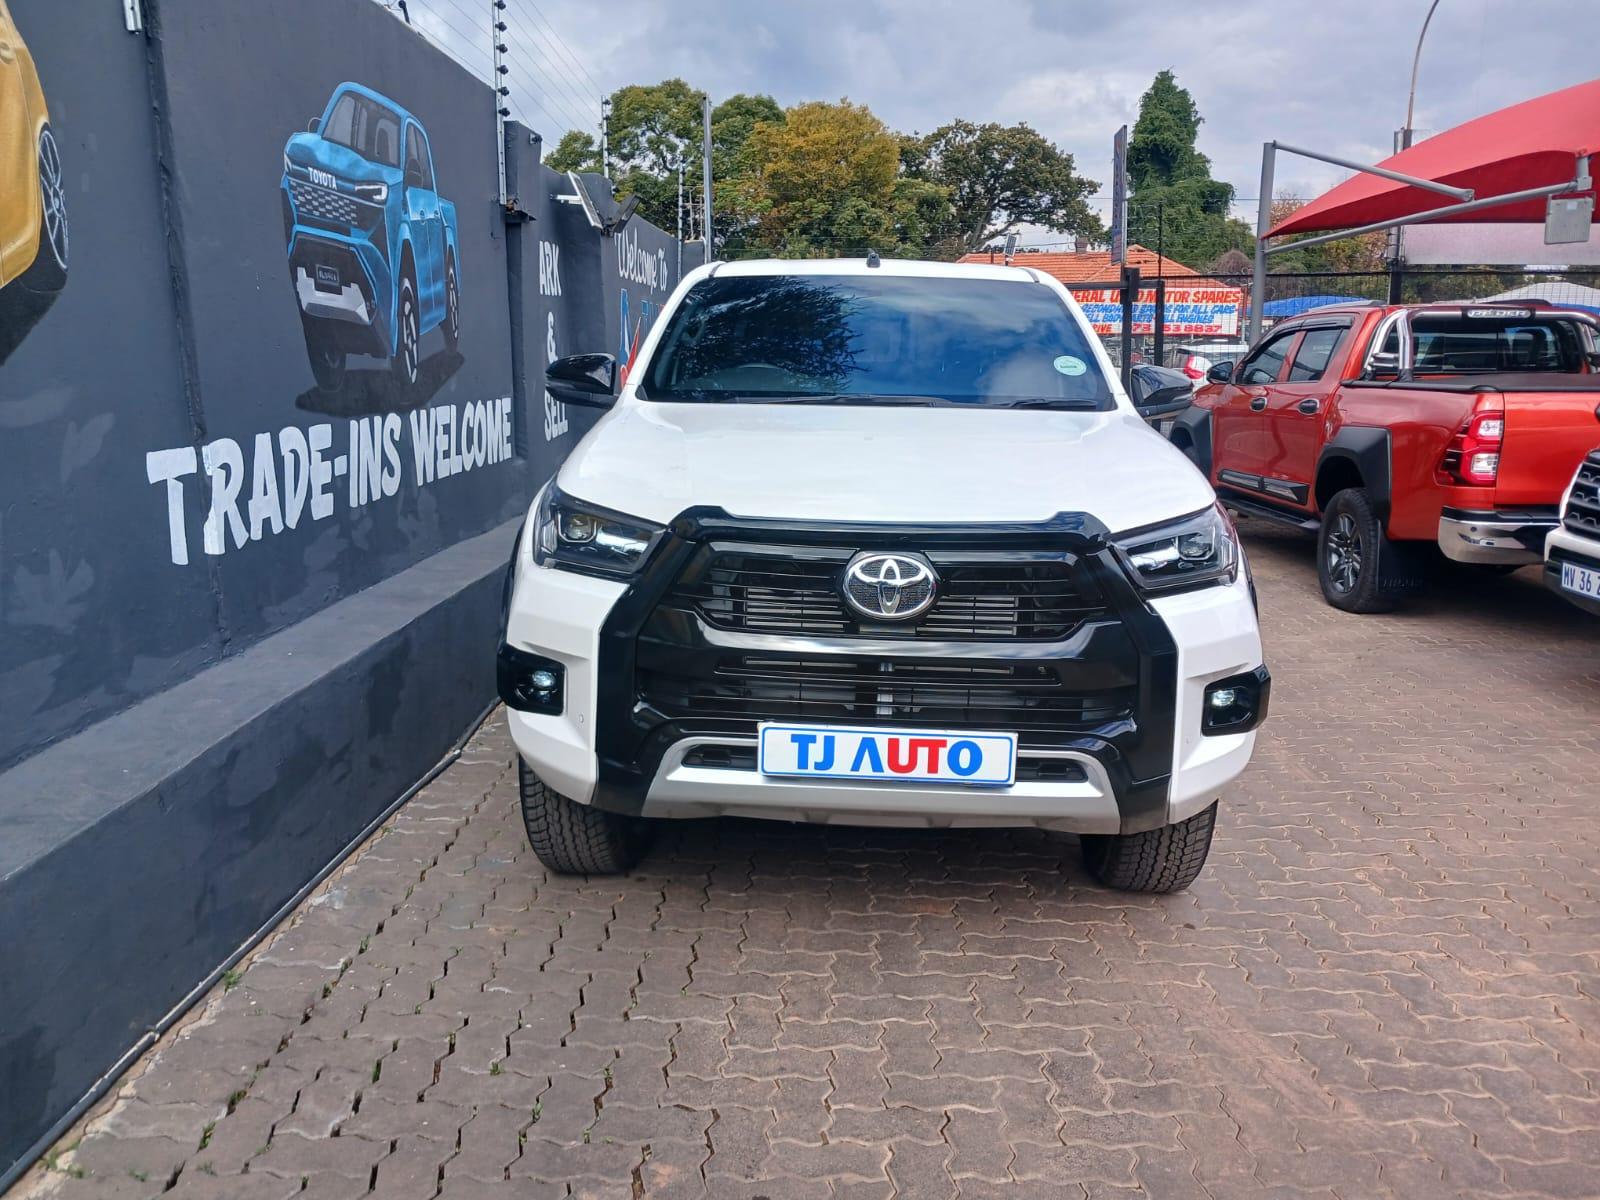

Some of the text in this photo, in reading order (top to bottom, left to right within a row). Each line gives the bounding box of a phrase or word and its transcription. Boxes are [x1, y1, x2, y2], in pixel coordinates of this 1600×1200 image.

[308, 166, 337, 190] TOYOTA
[614, 227, 657, 295] Welcome
[1071, 290, 1105, 302] ERAL
[1146, 290, 1191, 303] MTOR
[1192, 290, 1240, 303] SPARES
[1173, 304, 1190, 314] FOR
[1191, 304, 1210, 314] ALL
[544, 389, 568, 441] SELL
[146, 397, 513, 566] TRADE-INS WELCOME
[1579, 570, 1592, 592] 36
[790, 733, 983, 776] TJ AUTO
